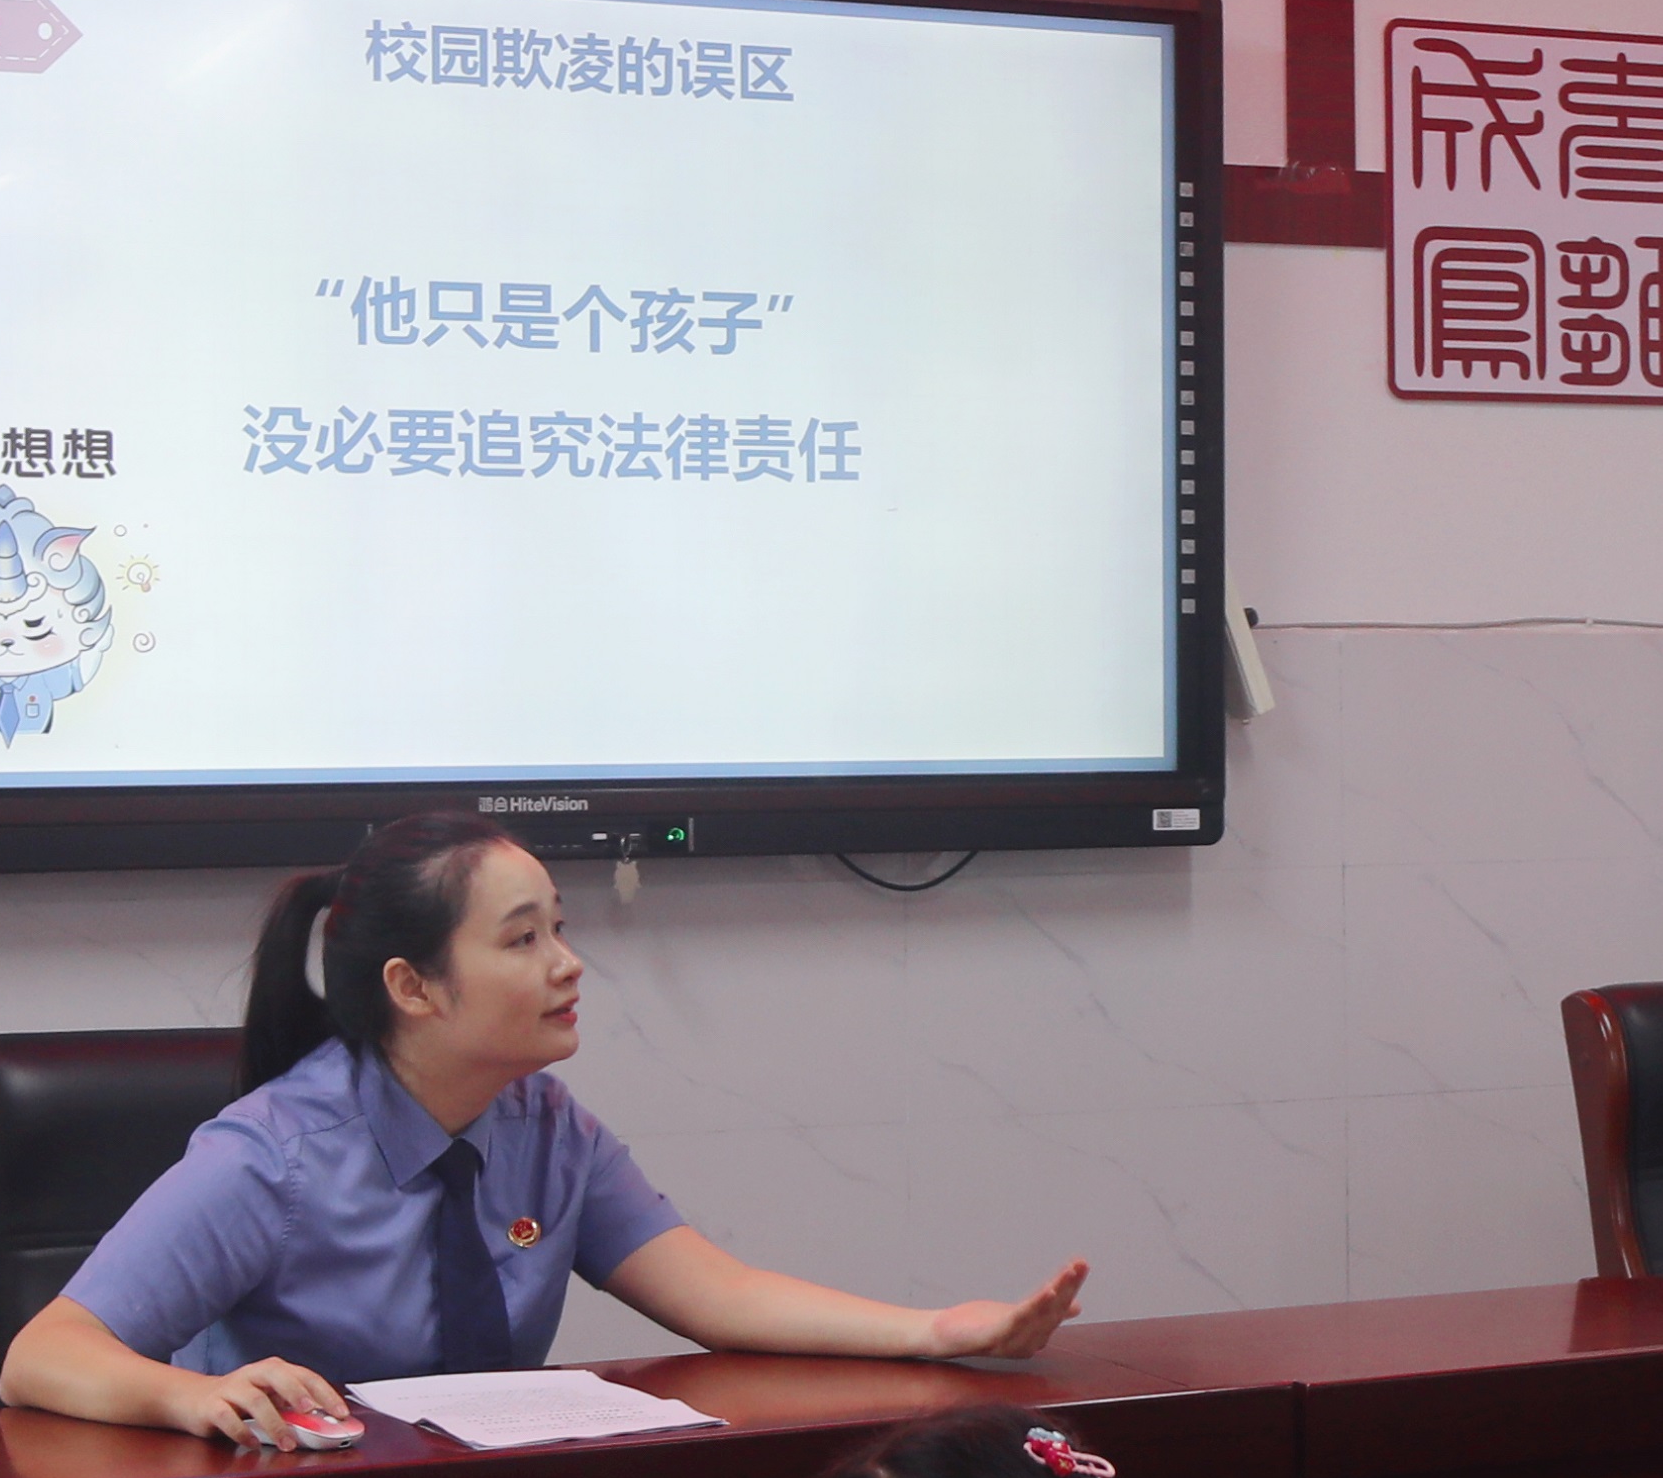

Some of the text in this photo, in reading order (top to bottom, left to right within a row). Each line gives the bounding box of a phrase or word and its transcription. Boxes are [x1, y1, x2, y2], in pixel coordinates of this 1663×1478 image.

[362, 18, 796, 105] 校园欺凌的误区
[314, 274, 796, 359] “他只是个孩子”
[240, 401, 863, 486] 没必要追究法律责任
